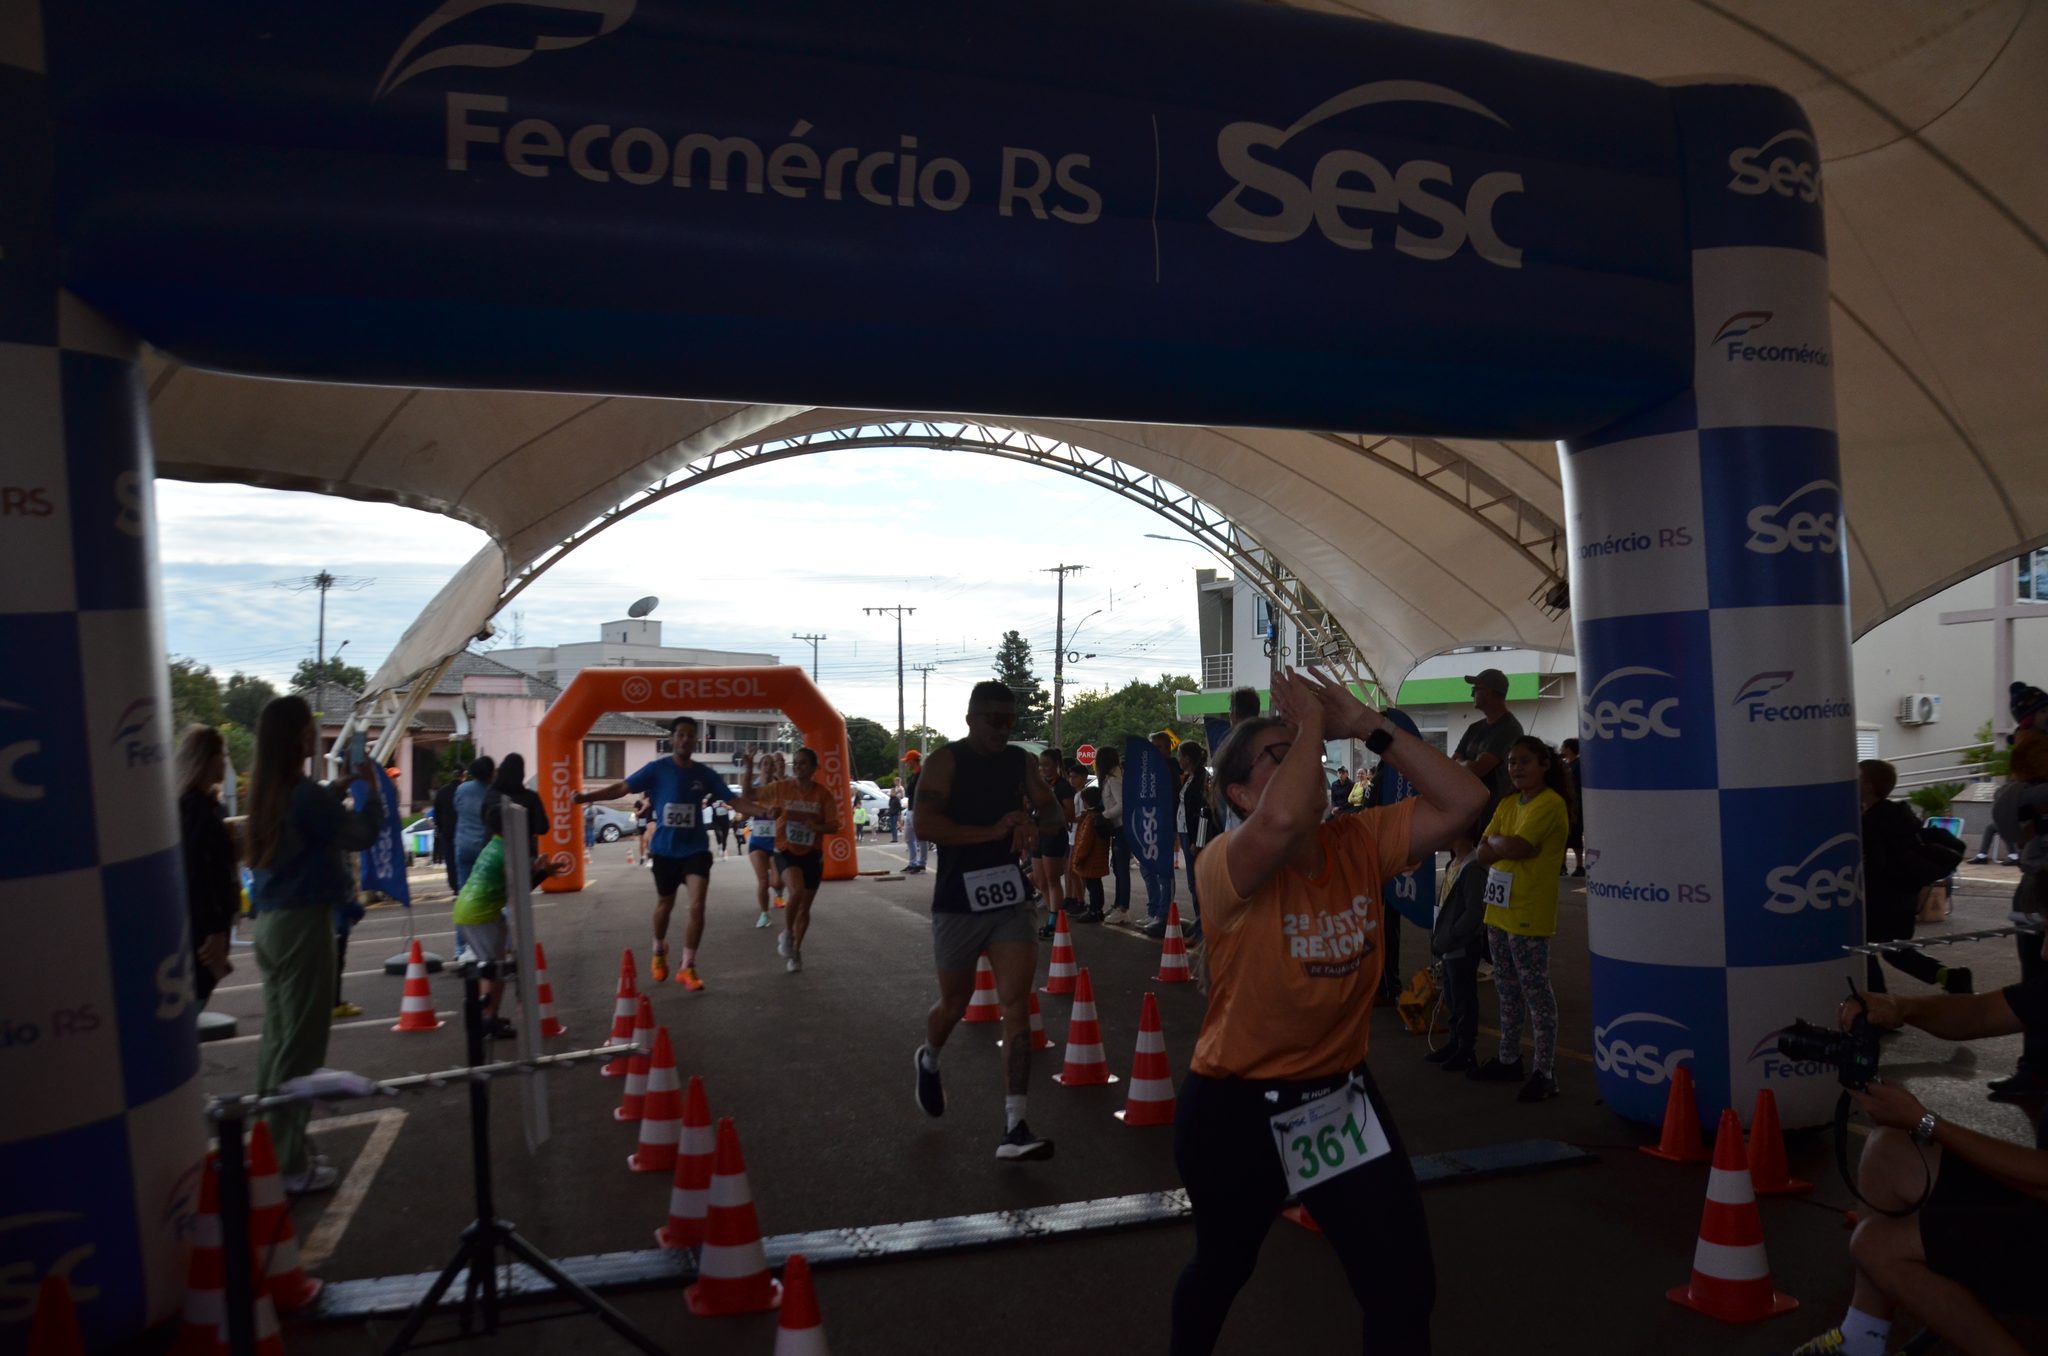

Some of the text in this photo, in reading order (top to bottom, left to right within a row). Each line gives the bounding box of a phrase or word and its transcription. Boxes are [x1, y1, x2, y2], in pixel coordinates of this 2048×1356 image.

[445, 91, 1103, 225] Fecomércio RS
[1207, 119, 1525, 269] Sesc
[1659, 526, 1693, 549] RS
[660, 677, 768, 699] CRESOL
[551, 754, 573, 845] CRESOL
[667, 812, 691, 826] 504
[1141, 806, 1159, 861] Sesc
[975, 881, 1017, 907] 689
[1587, 880, 1711, 904] ecomércio RS
[51, 1003, 100, 1039] RS
[1291, 1111, 1368, 1179] 361
